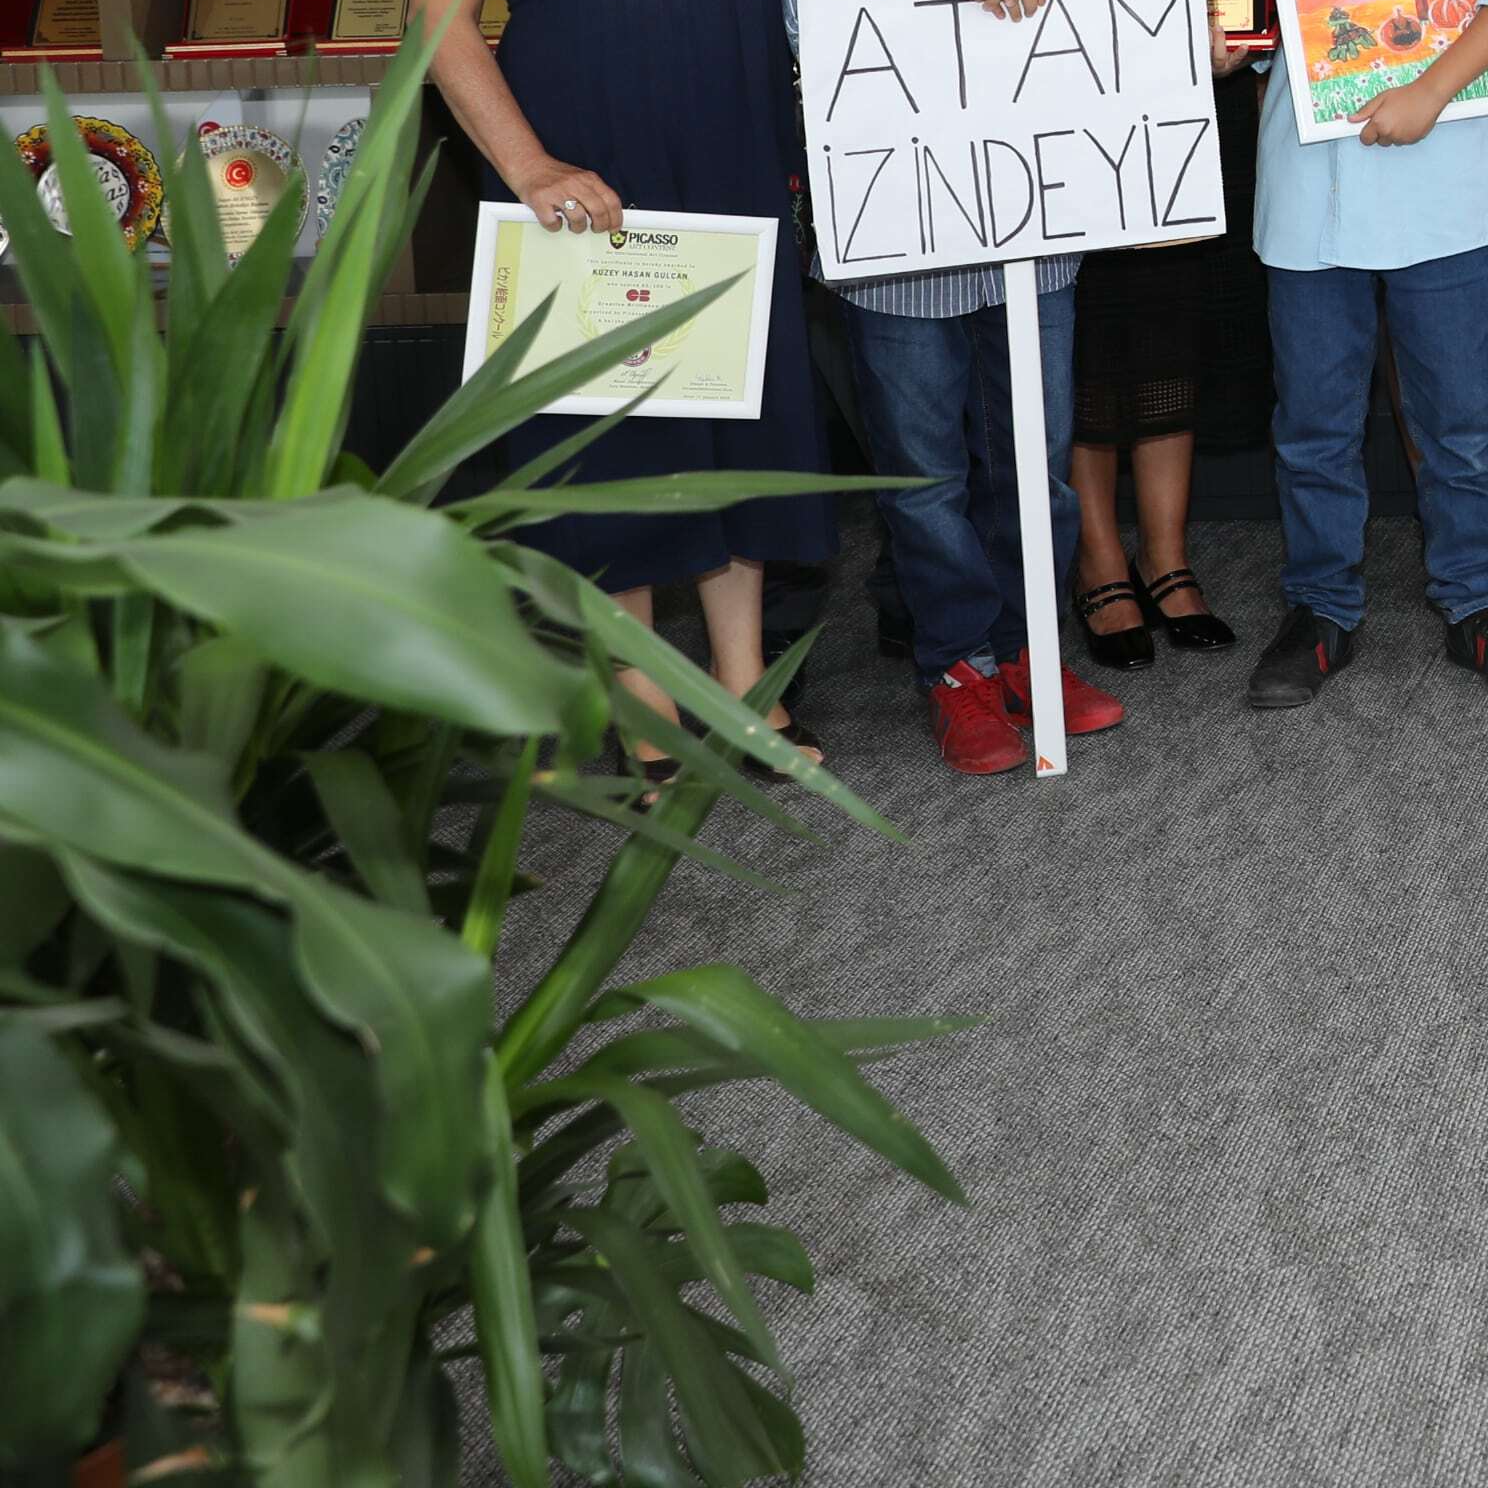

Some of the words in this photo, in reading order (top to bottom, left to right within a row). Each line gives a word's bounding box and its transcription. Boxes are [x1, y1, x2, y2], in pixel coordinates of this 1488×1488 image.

[822, 113, 1217, 264] İZİNDEYİZ
[629, 232, 679, 246] PICASSO
[592, 269, 620, 277] KUZEY
[622, 270, 651, 278] HASAN
